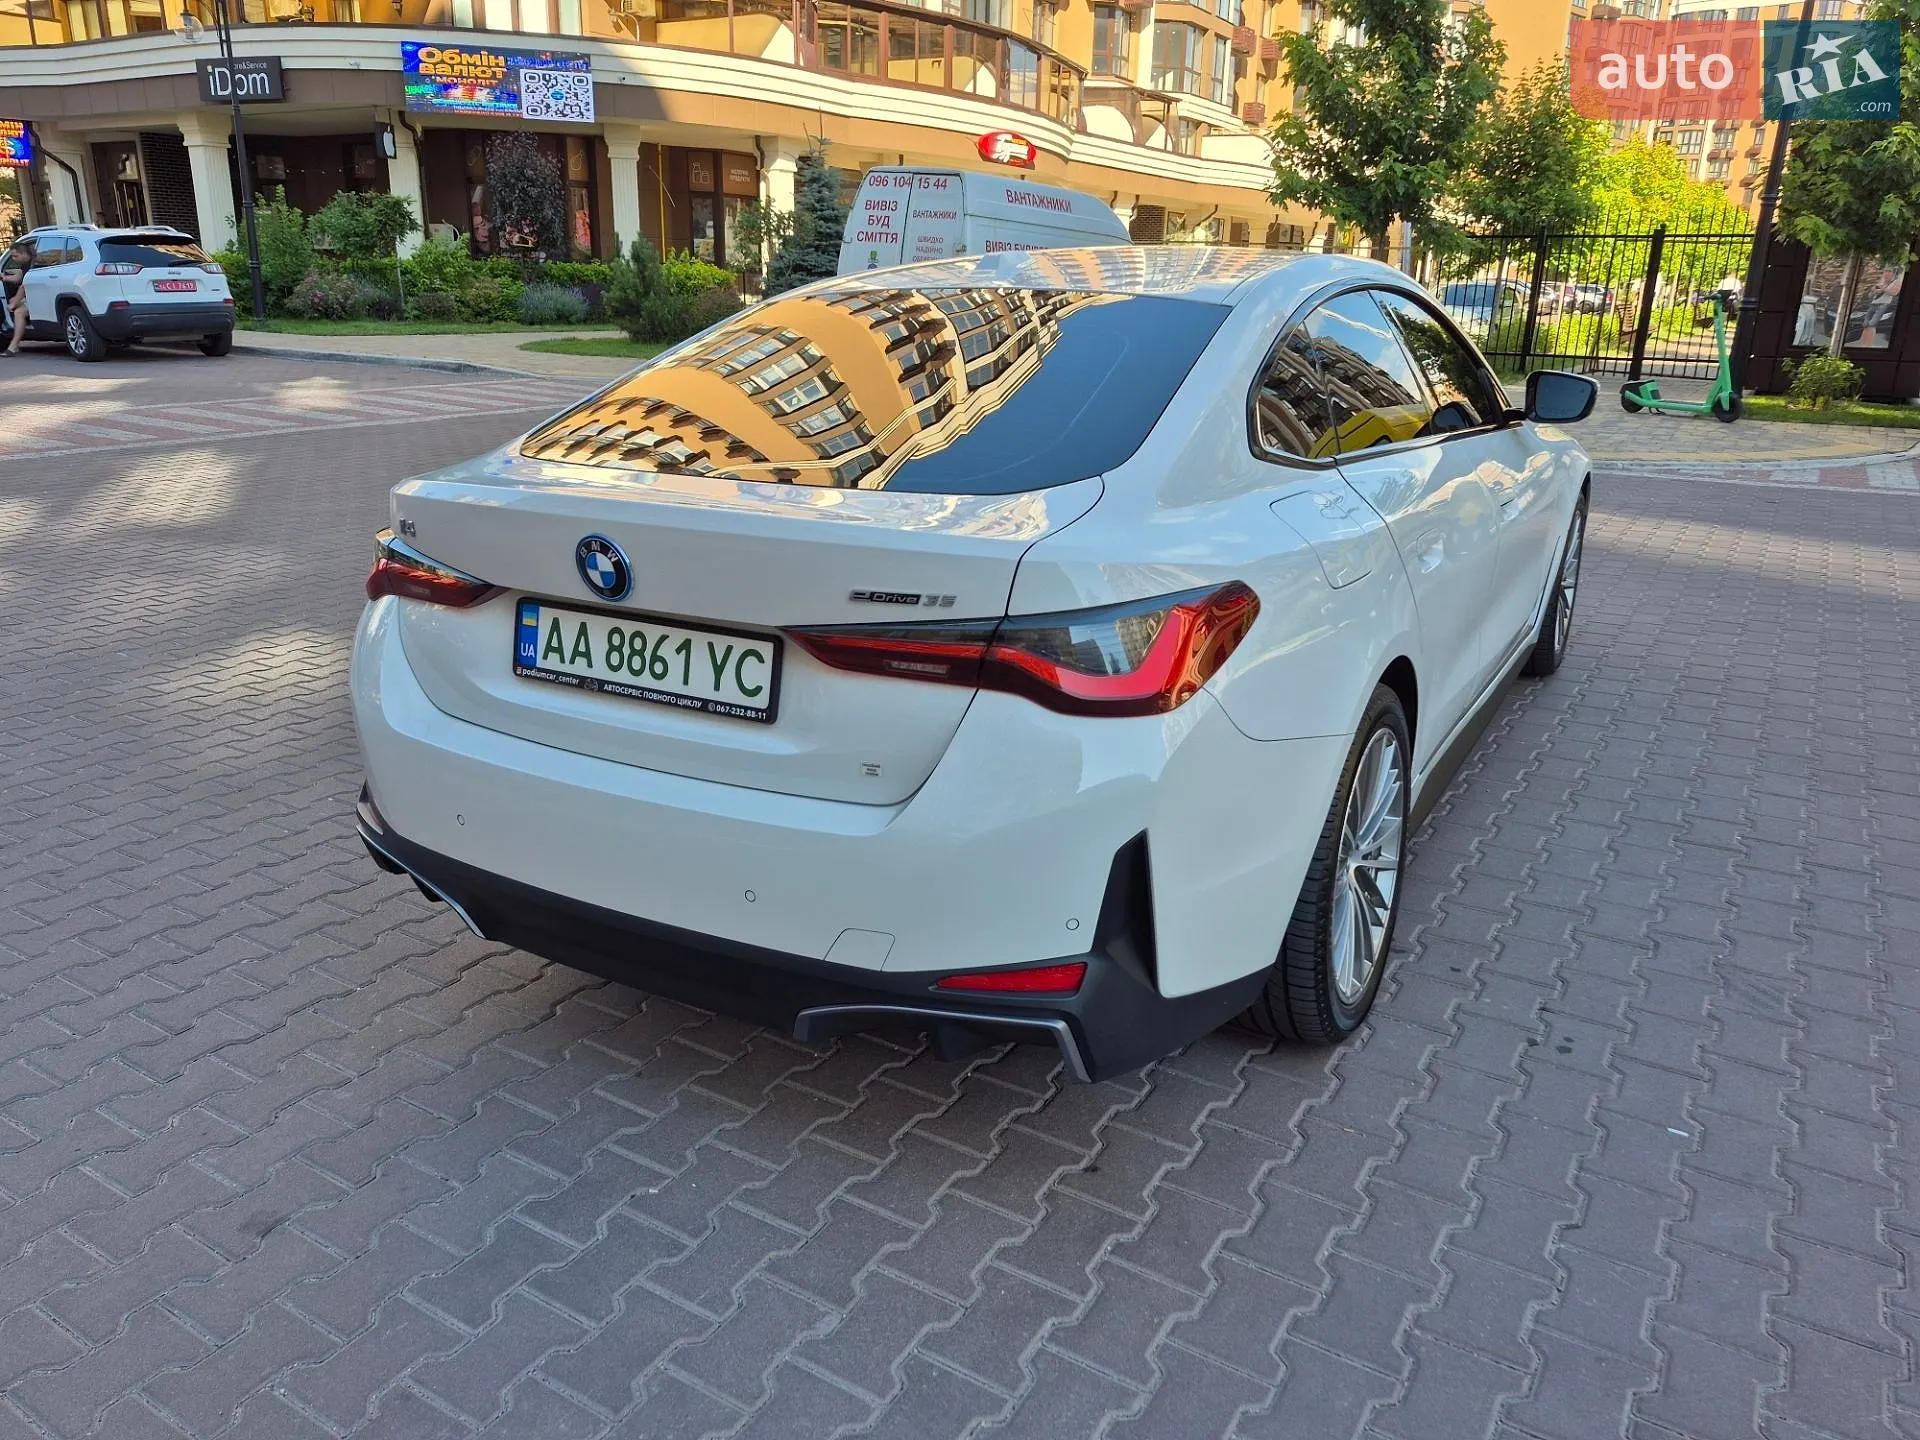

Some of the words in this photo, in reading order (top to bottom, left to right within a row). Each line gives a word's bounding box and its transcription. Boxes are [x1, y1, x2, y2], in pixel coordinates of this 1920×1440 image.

[418, 47, 505, 67] Обмін
[868, 175, 889, 187] 096
[893, 176, 912, 188] 104
[918, 177, 930, 189] 15
[933, 178, 948, 190] 44
[864, 199, 898, 211] ВИВІЗ
[1006, 188, 1072, 213] ВАНТАЖНИКИ
[867, 215, 891, 228] БУД
[912, 209, 957, 220] ВАНТАЖНИКИ
[856, 230, 898, 243] СМІТТЯ
[520, 642, 536, 658] UA
[542, 616, 593, 669] AA
[605, 626, 692, 685] 8861
[643, 691, 676, 704] ПОВНОГО
